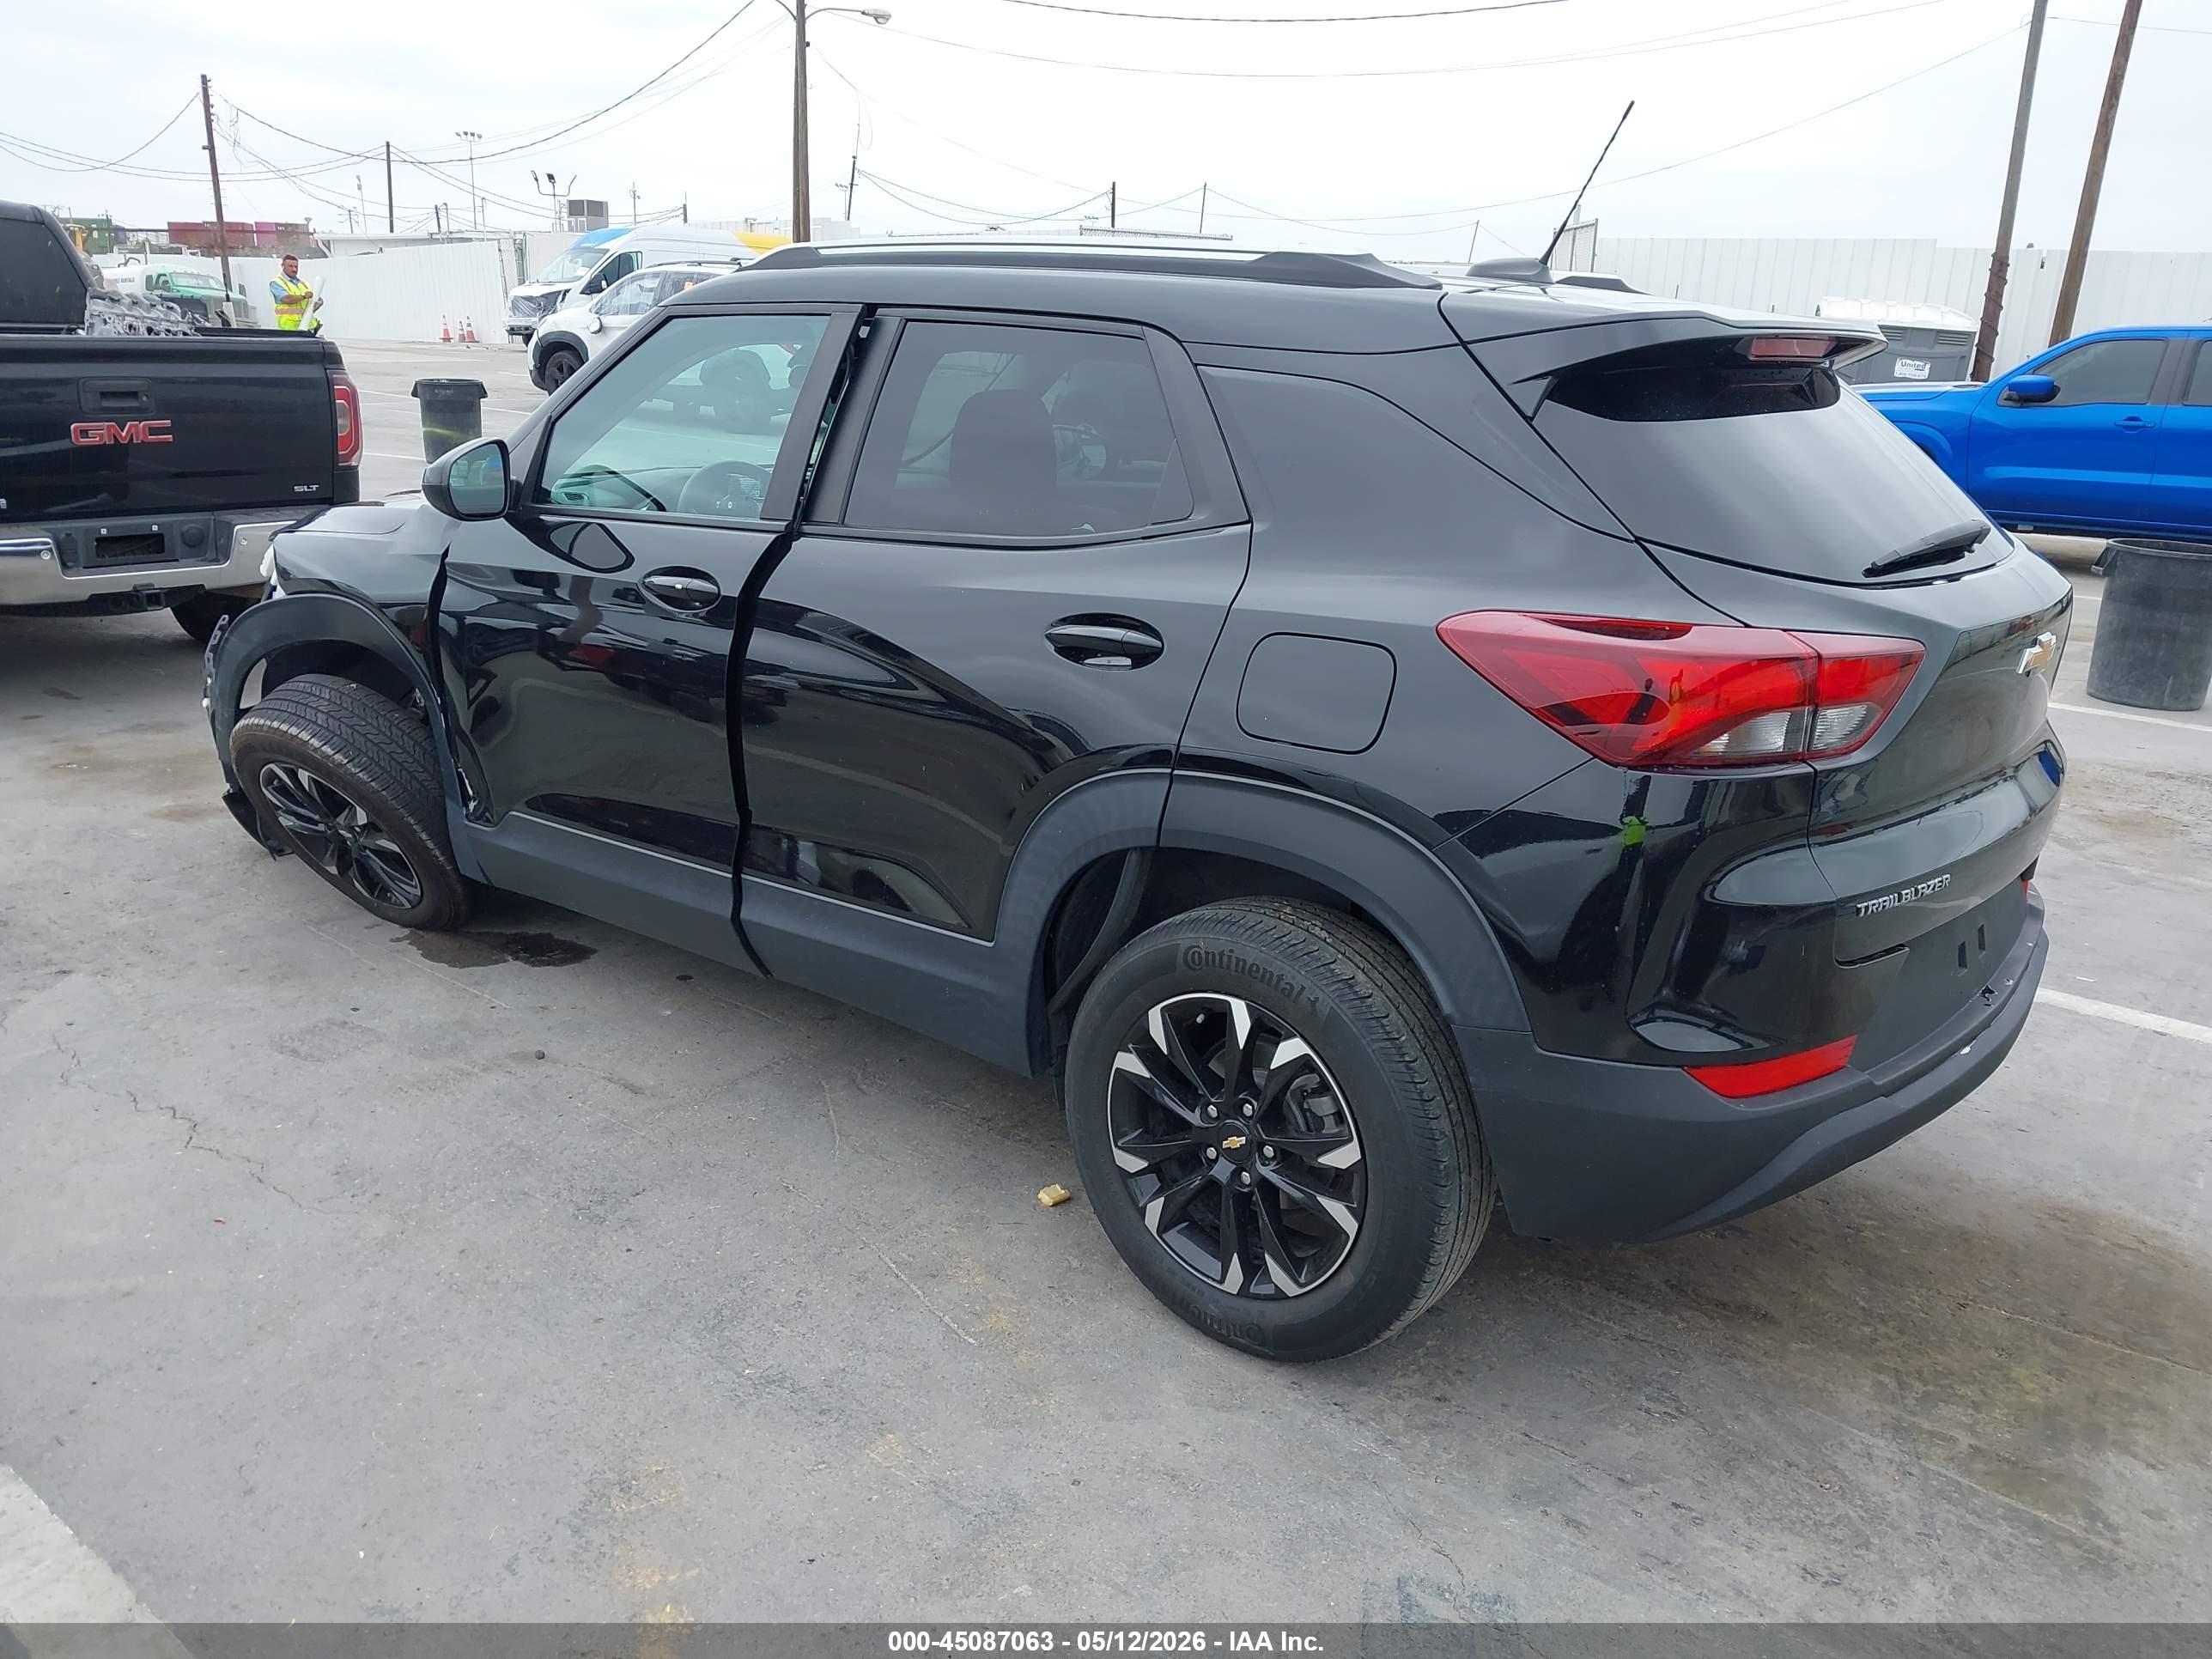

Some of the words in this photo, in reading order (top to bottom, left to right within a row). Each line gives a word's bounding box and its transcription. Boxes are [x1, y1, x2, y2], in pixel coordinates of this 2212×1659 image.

[1900, 361, 1926, 369] United
[70, 420, 173, 445] GMC
[1856, 874, 1951, 917] TRAILBLAZER
[1182, 944, 1306, 1003] Continental
